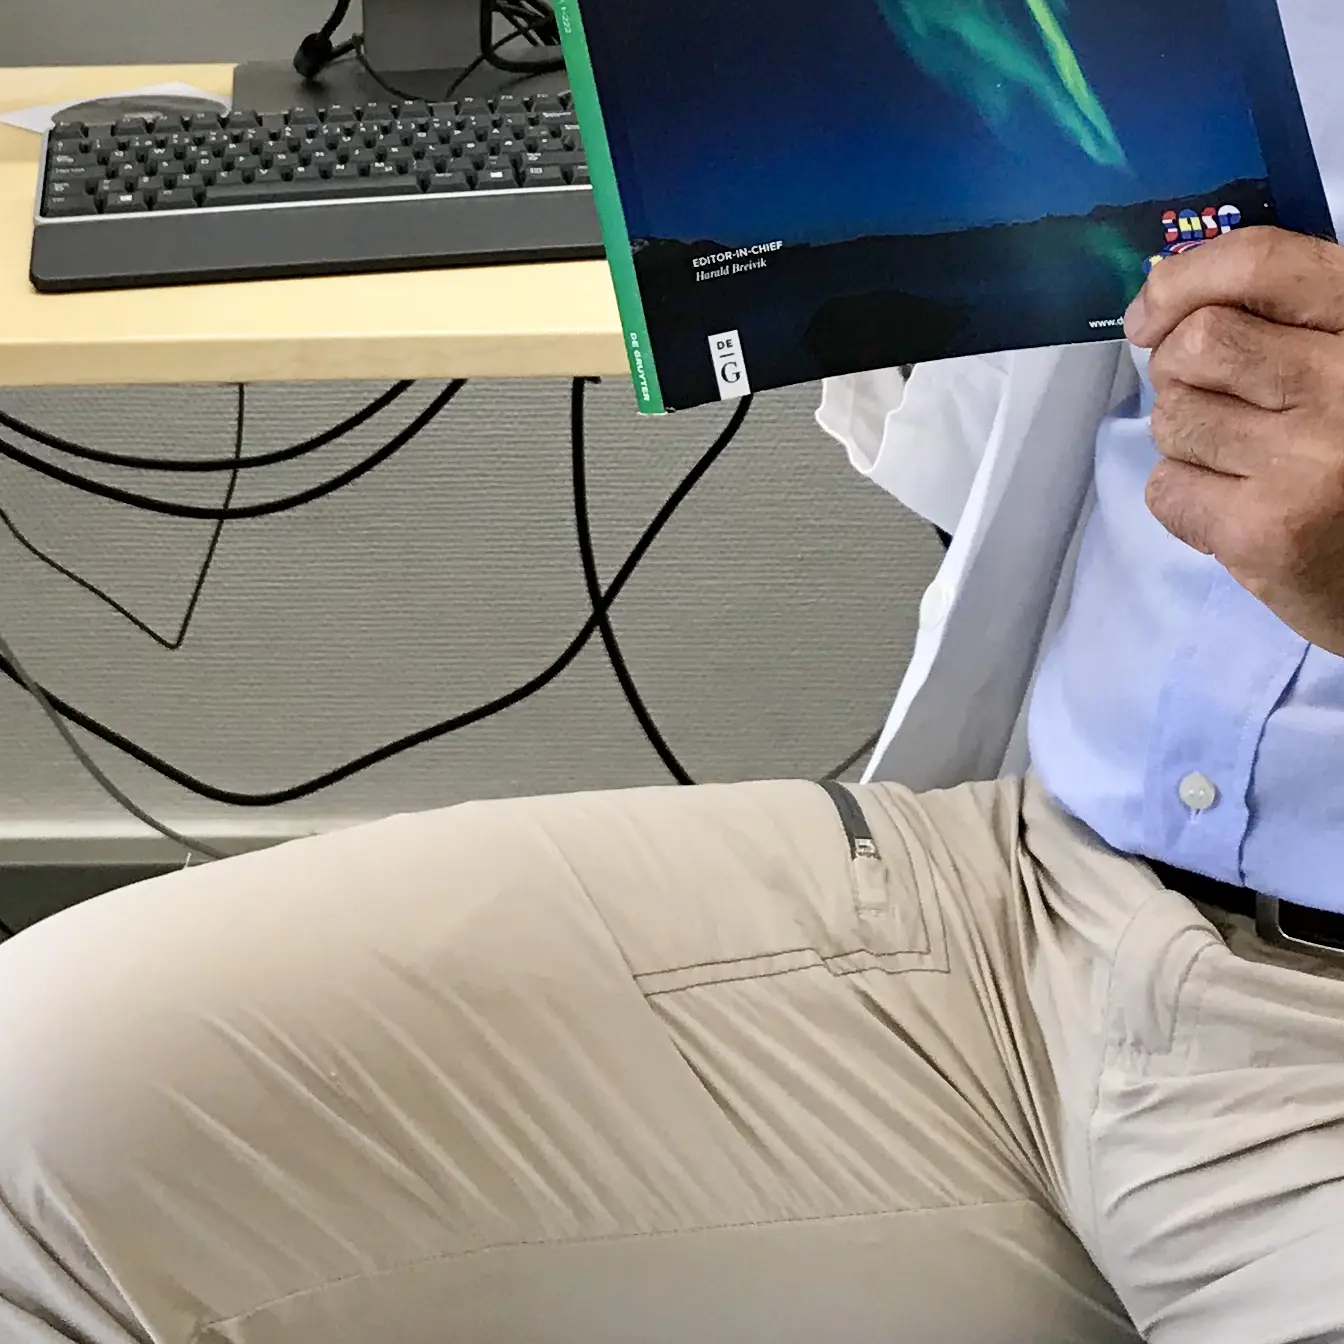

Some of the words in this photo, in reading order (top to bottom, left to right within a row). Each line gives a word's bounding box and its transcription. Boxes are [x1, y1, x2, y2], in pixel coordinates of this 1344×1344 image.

[1161, 204, 1242, 242] SASP
[692, 240, 783, 268] EDITOR-IN-CHIEF
[695, 264, 730, 282] Harald
[732, 258, 767, 275] Breivik
[1088, 316, 1124, 329] www.d
[629, 332, 639, 348] DE
[716, 339, 733, 350] DE
[633, 350, 650, 402] GRUYTER
[721, 361, 742, 383] G
